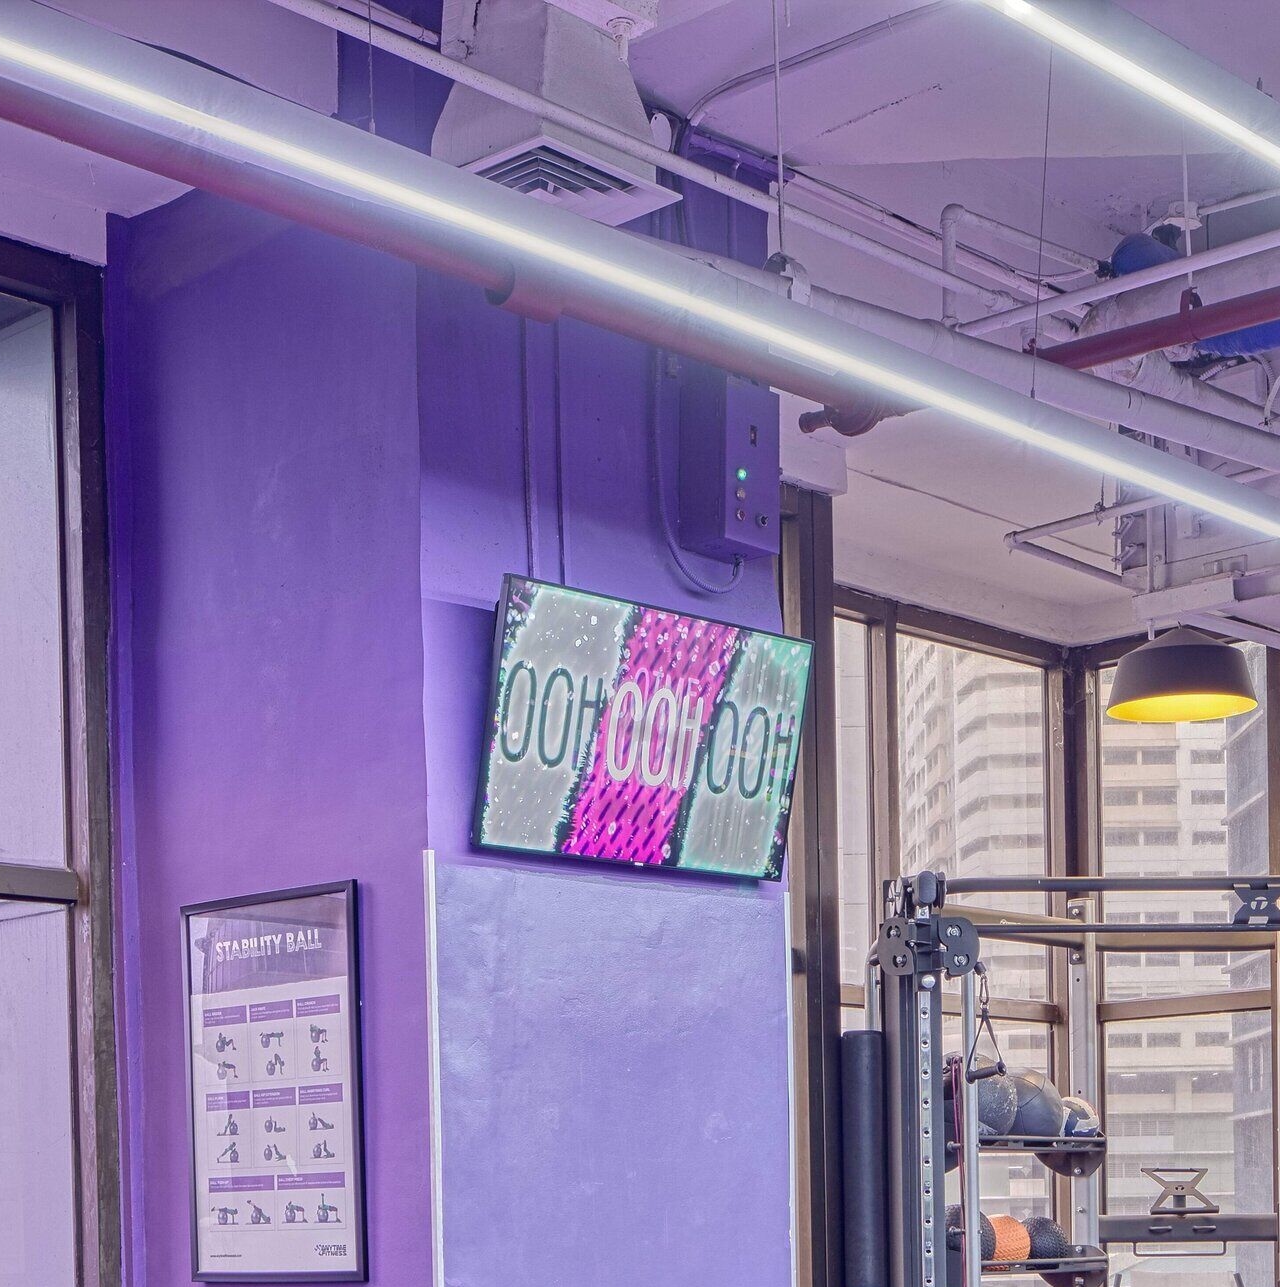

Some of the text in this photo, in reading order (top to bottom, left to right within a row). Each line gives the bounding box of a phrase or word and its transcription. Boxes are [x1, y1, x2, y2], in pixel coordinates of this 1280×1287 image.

[499, 660, 605, 771] OOH
[607, 681, 704, 790] OOH
[706, 698, 797, 801] OOH
[215, 929, 322, 962] STABILITY BALL
